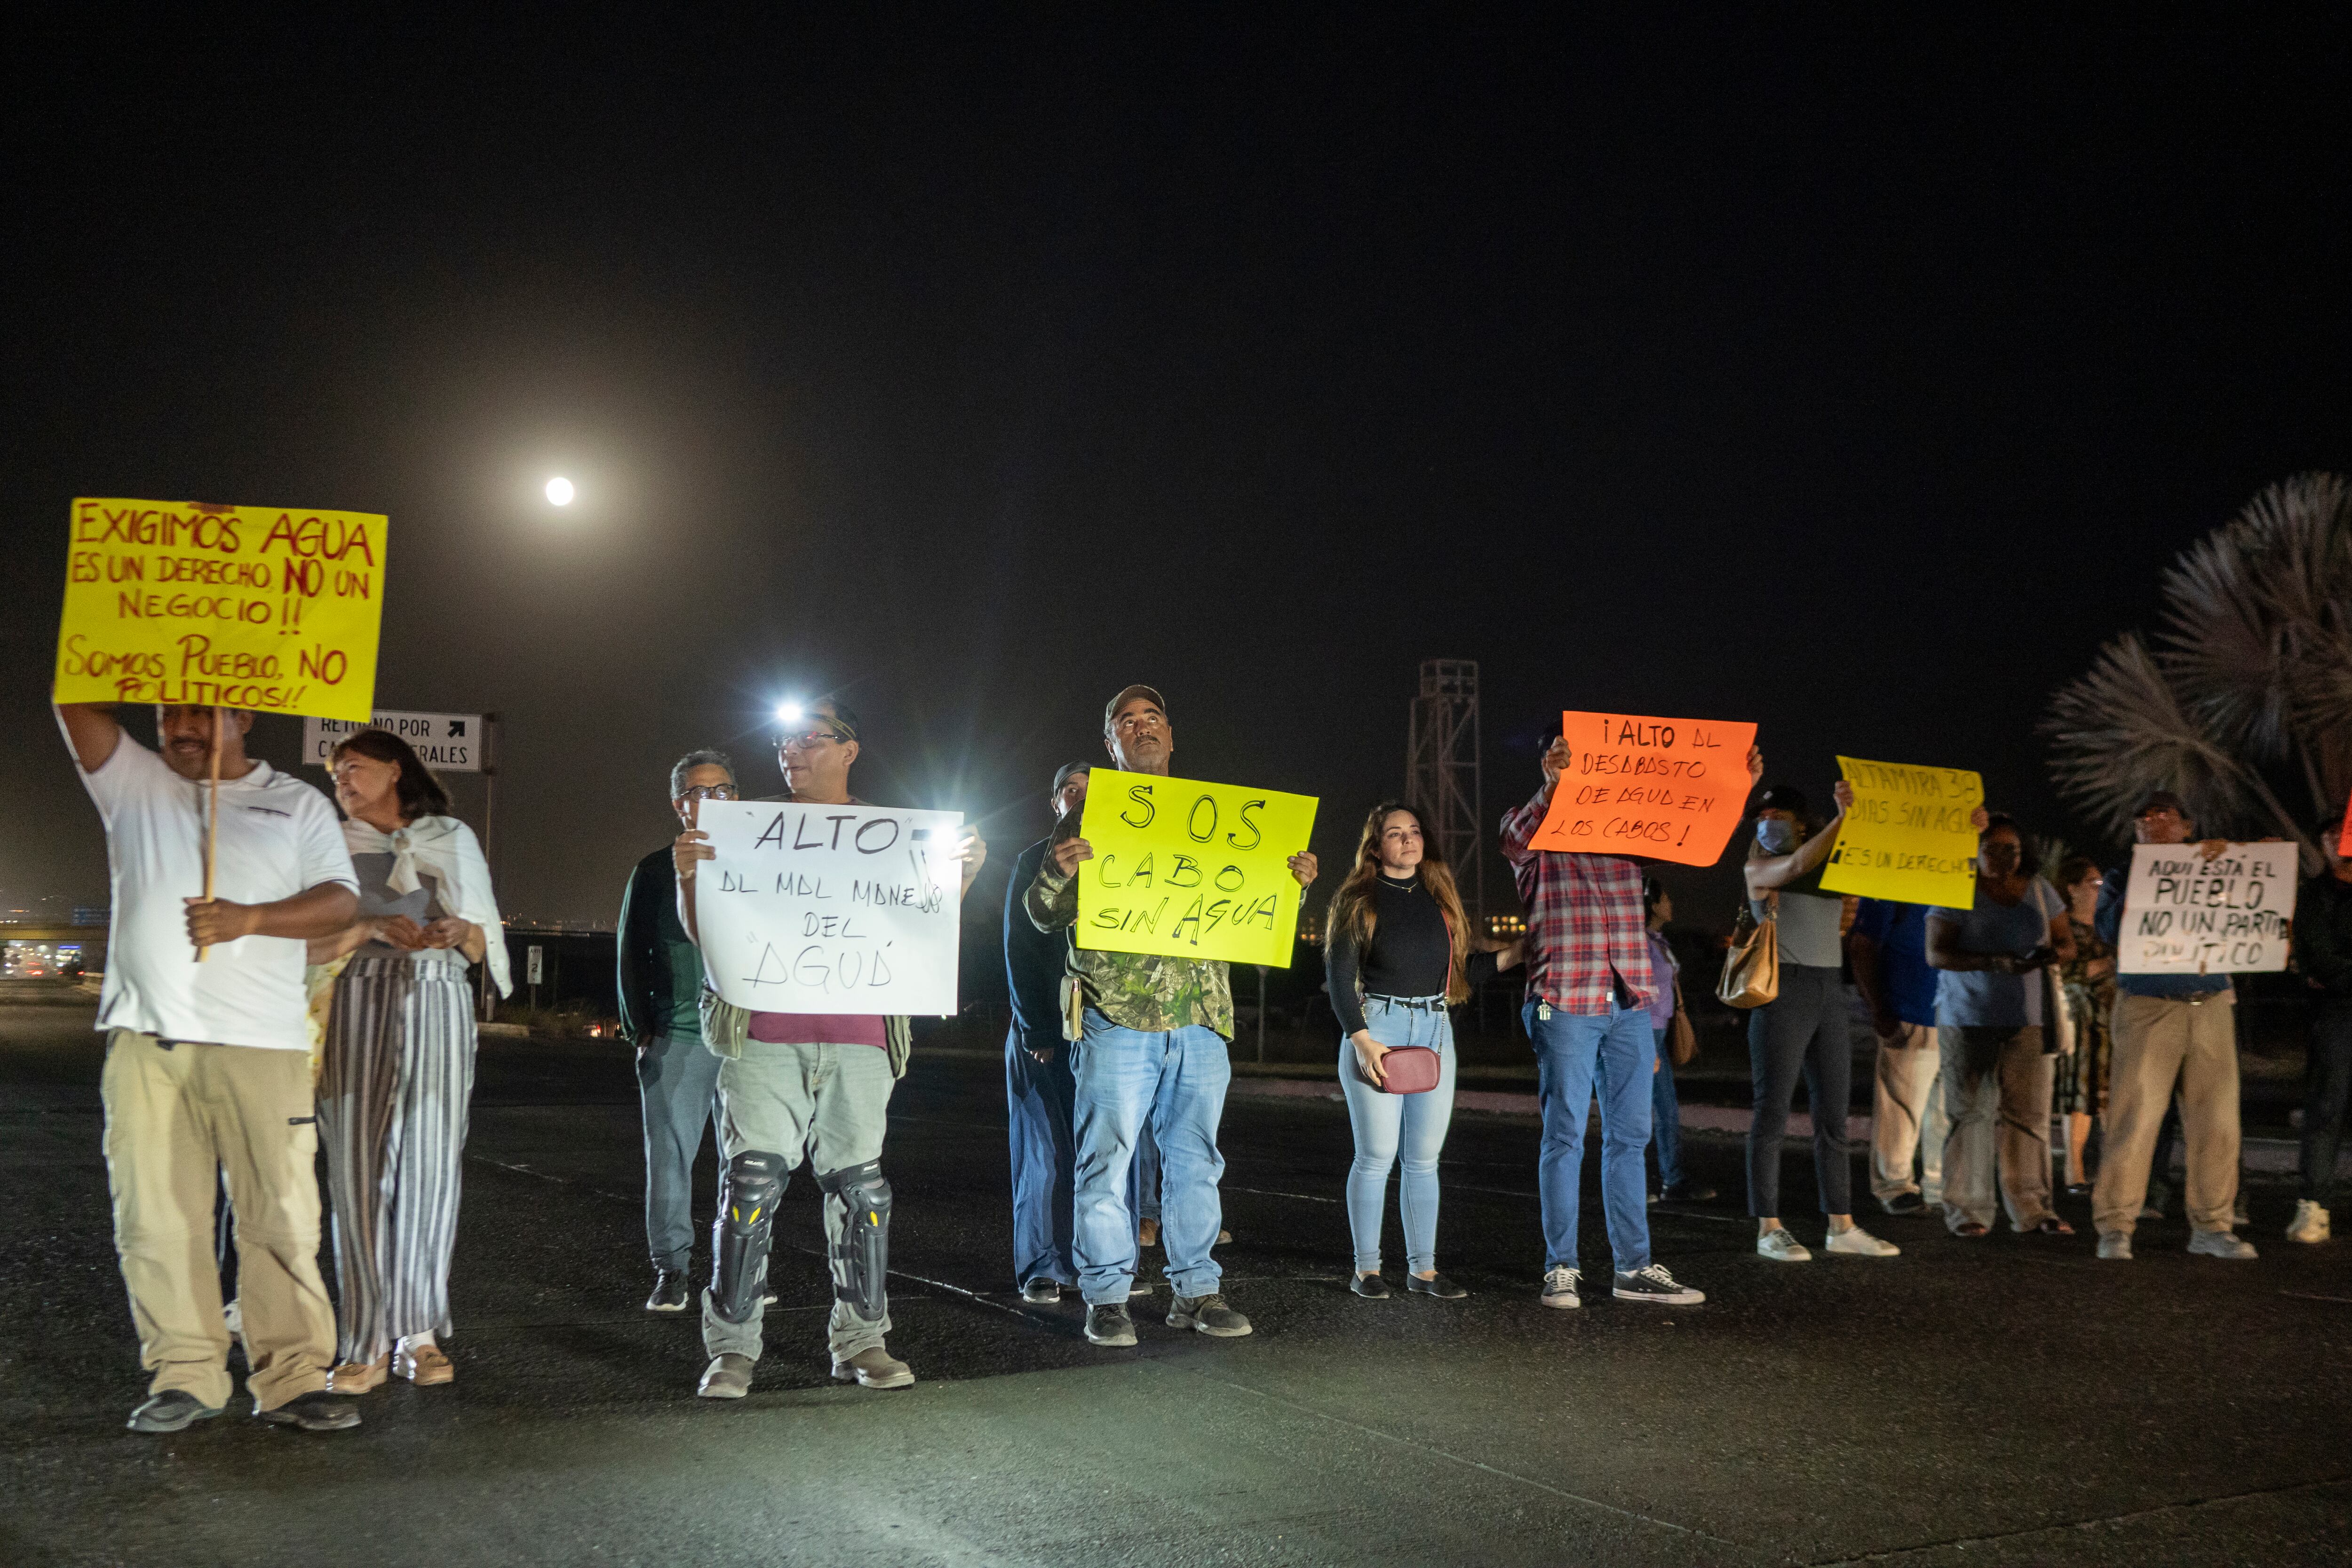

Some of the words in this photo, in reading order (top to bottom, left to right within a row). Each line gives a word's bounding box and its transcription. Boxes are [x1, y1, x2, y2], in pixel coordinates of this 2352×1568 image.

[75, 502, 242, 554] EXIGIMOS
[259, 513, 375, 567] AGUA
[72, 551, 100, 582] ES
[106, 556, 144, 582] UN
[283, 557, 325, 597] NO
[335, 570, 370, 600] UN
[298, 643, 348, 685] NO
[399, 719, 430, 736] POR
[1575, 785, 1611, 805] DE
[1678, 796, 1715, 813] EN
[1550, 820, 1593, 836] LOS
[1895, 802, 1931, 828] SIN
[1099, 852, 1244, 892] CABO
[1876, 851, 1893, 868] UN
[2251, 861, 2277, 878] EL
[2154, 879, 2265, 910] PUEBLO
[803, 912, 867, 938] DEL
[1090, 896, 1169, 934] SIN
[1172, 893, 1277, 946] AGUA
[2138, 911, 2173, 936] NO
[2181, 909, 2216, 933] UN
[532, 963, 538, 972] 2
